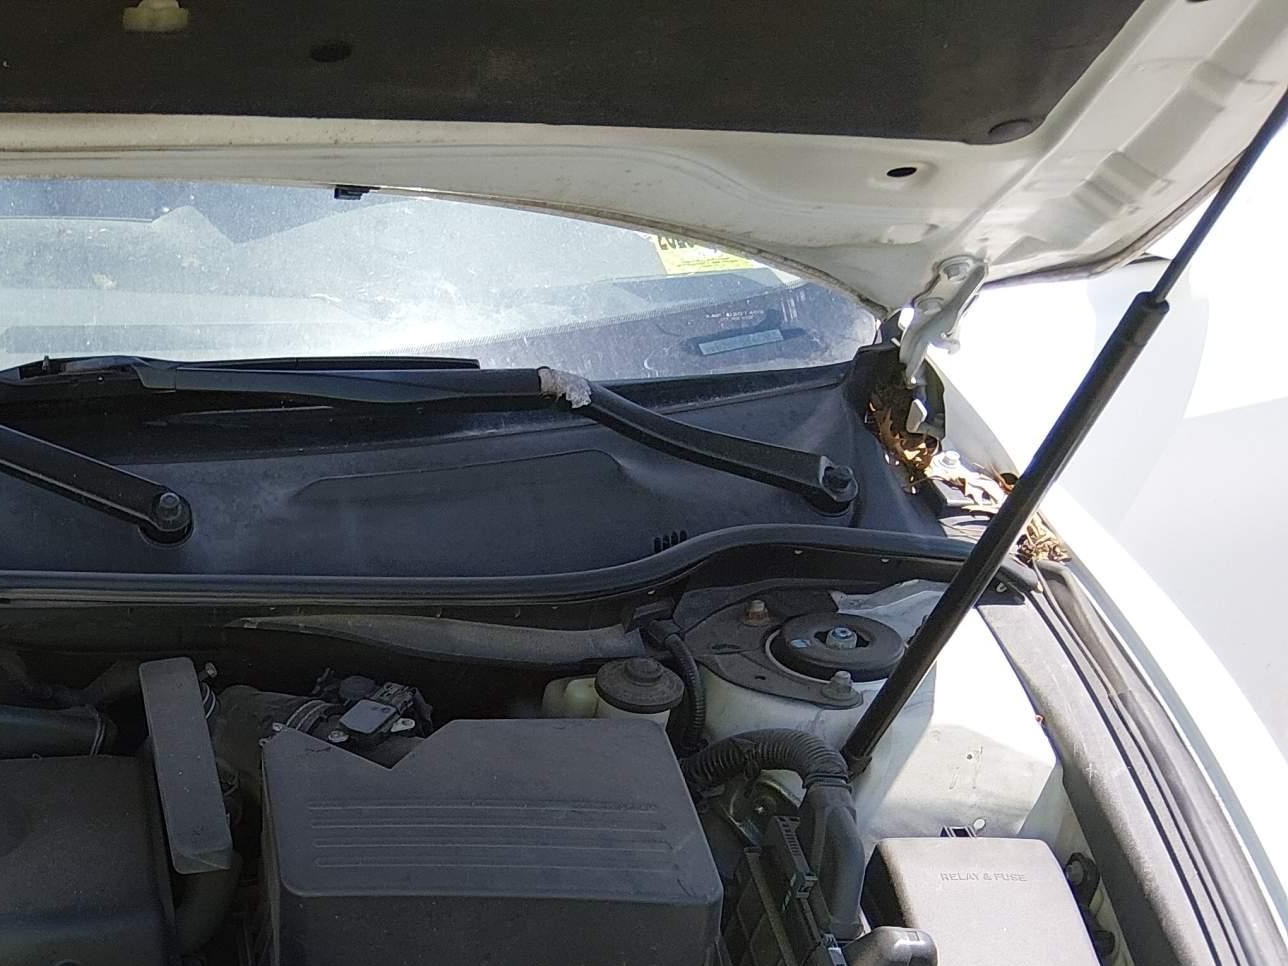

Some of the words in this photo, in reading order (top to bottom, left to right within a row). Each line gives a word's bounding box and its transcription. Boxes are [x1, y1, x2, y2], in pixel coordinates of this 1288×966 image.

[939, 871, 980, 881] RELAY
[982, 872, 993, 881] &
[993, 873, 1028, 882] FUSE
